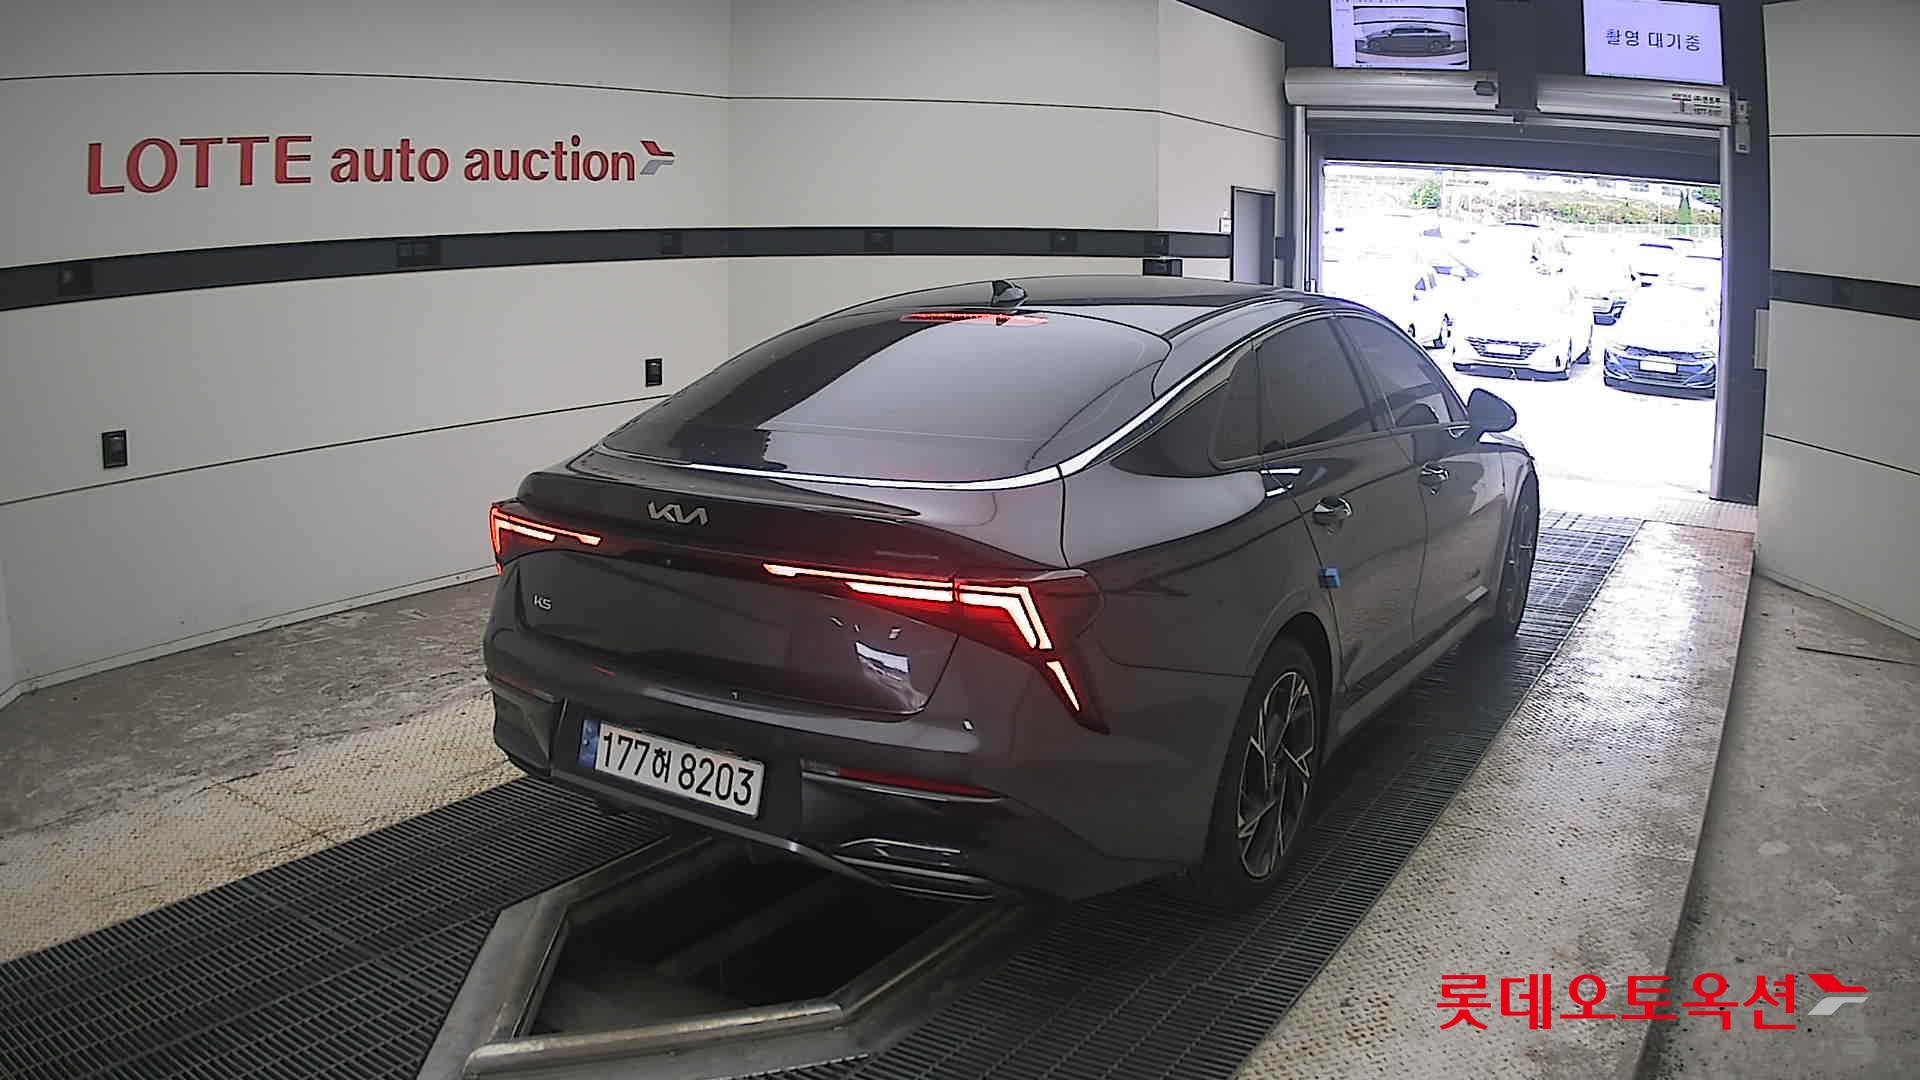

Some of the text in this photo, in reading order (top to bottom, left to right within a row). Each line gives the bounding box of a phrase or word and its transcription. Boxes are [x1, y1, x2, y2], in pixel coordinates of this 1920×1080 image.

[1648, 32, 1701, 52] 대기중
[87, 134, 635, 195] LOTTE auto auction
[647, 501, 709, 525] KIA
[603, 732, 755, 806] 177허 8203
